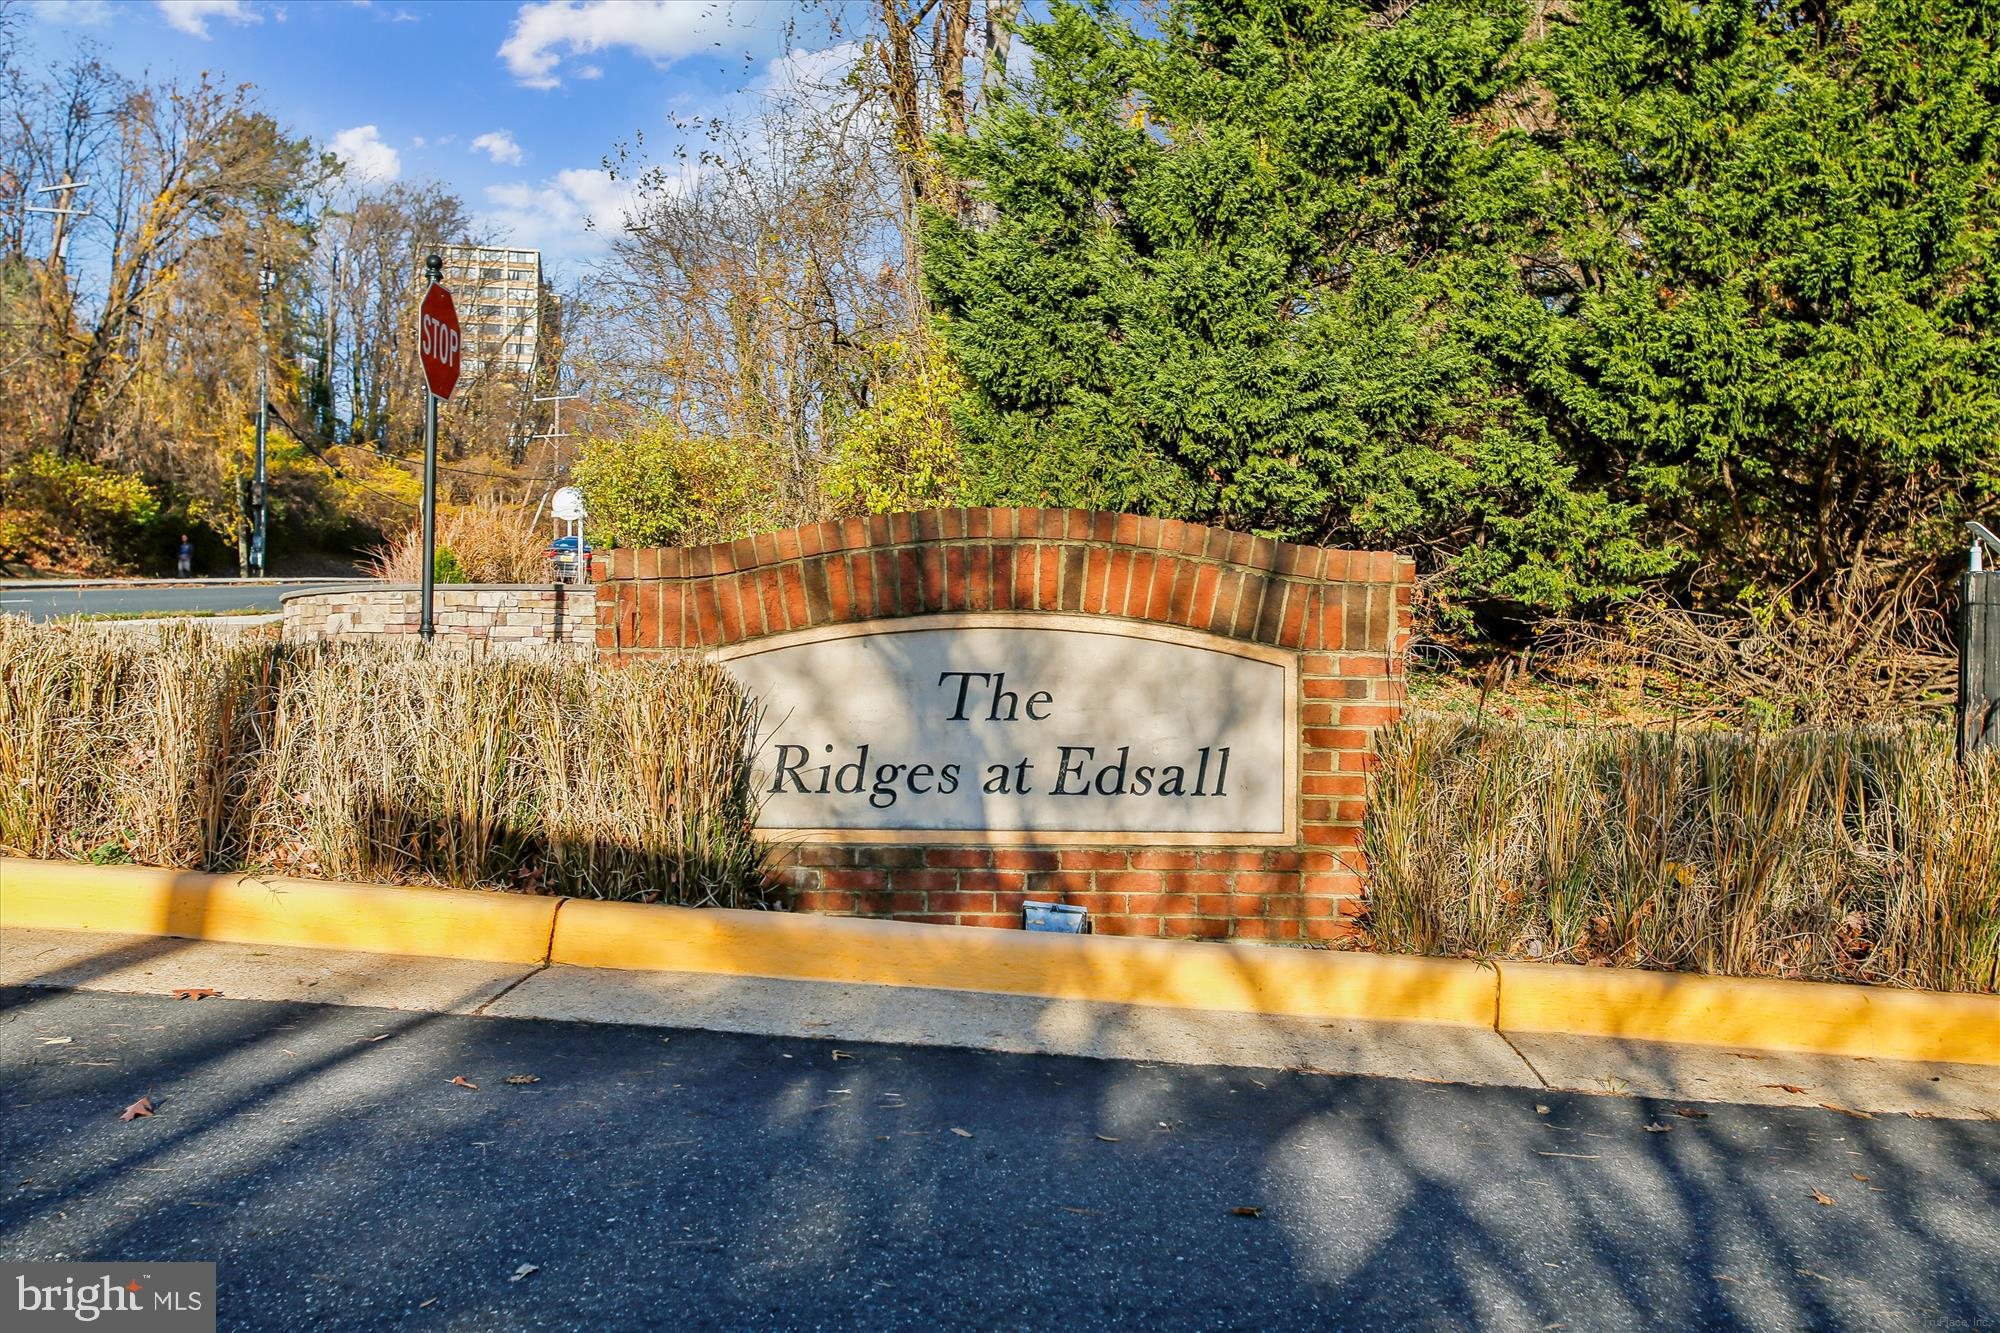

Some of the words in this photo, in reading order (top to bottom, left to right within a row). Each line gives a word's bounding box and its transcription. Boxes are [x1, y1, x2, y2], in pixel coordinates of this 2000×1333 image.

[422, 313, 458, 367] STOP
[937, 671, 1053, 722] The
[766, 743, 961, 809] Ridges
[982, 757, 1035, 795] at
[1048, 746, 1230, 797] Edsall
